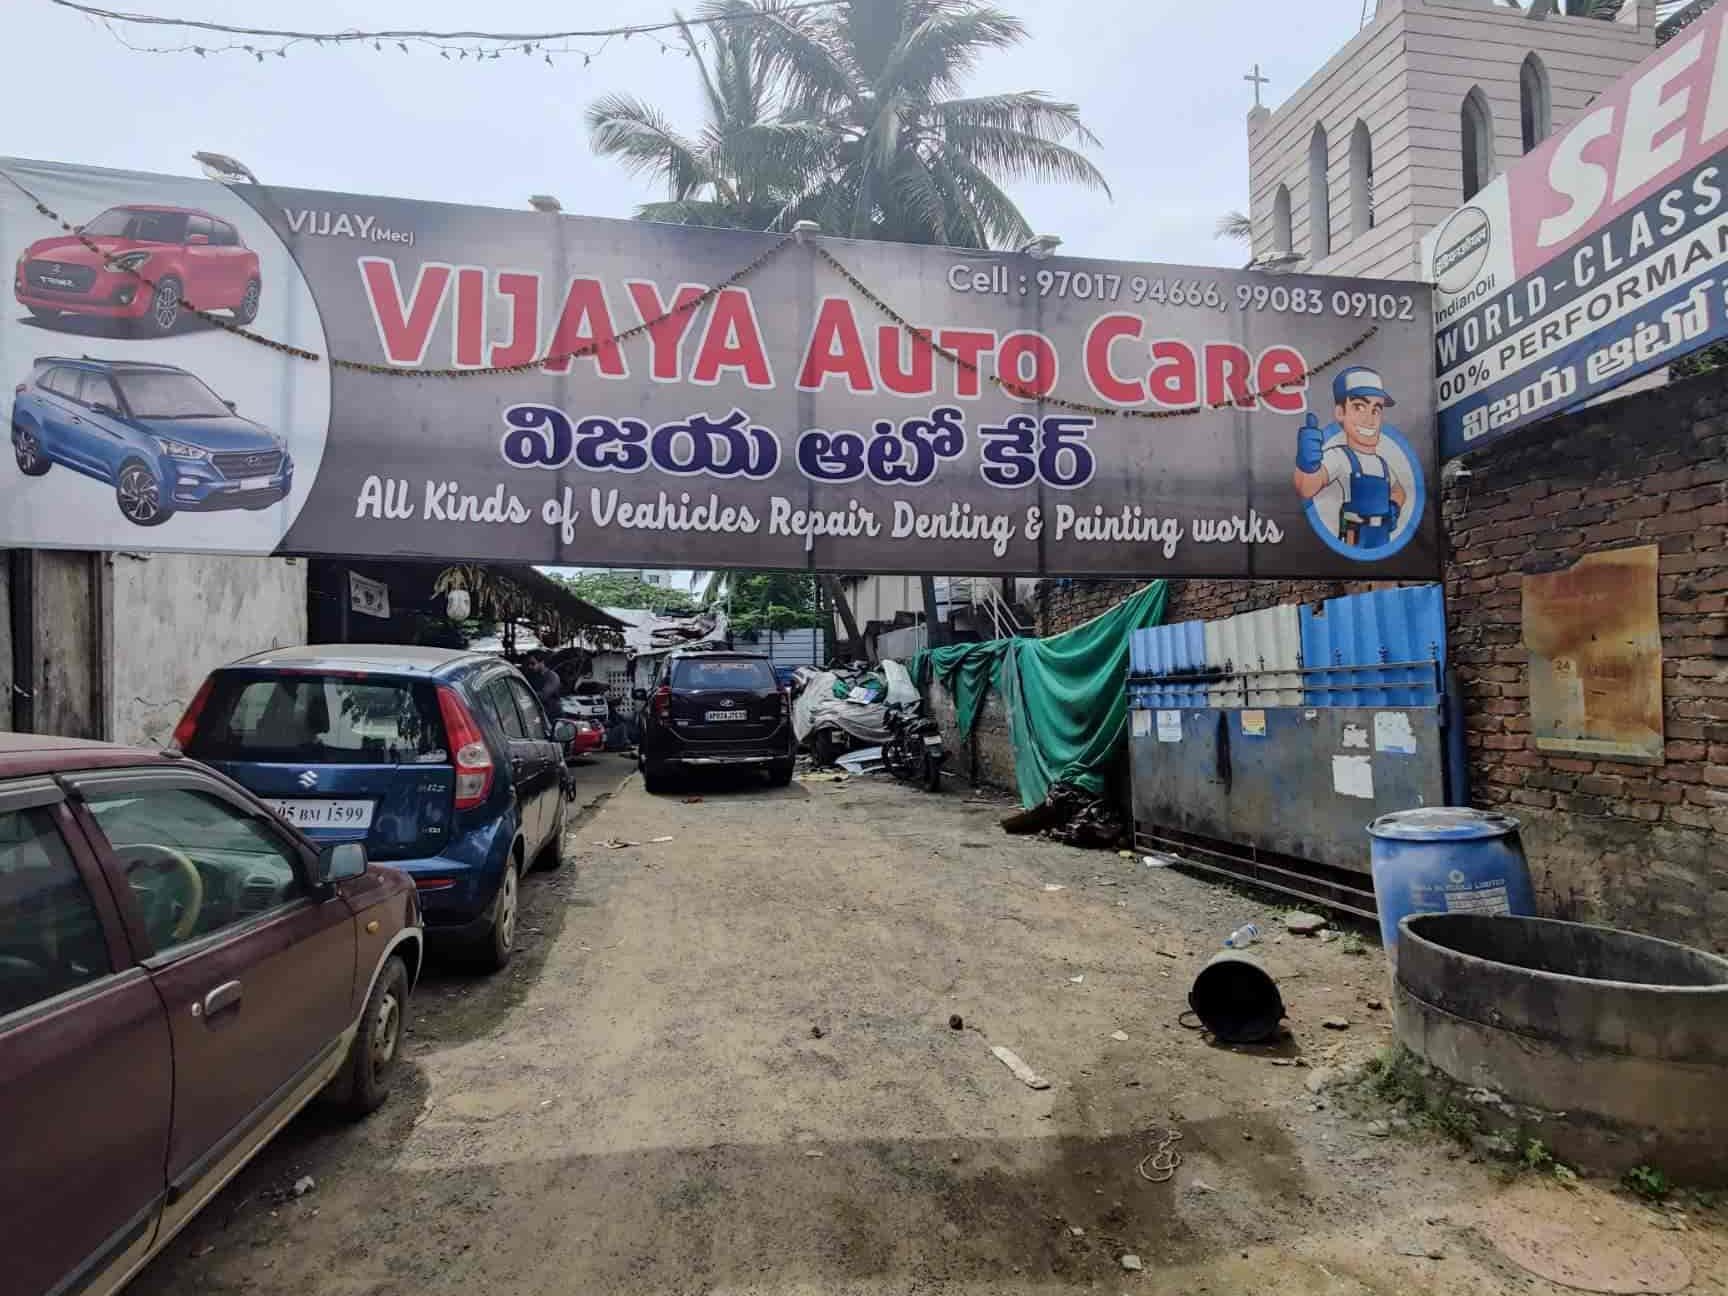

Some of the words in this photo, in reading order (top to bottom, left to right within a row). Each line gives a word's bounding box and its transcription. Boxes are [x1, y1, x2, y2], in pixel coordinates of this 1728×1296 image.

[948, 264, 1008, 296] Cell
[1036, 270, 1121, 301] 97017
[1132, 278, 1227, 312] 94666,
[1236, 284, 1323, 312] 99083
[1332, 292, 1414, 320] 09102
[1435, 272, 1495, 325] IndianOil
[1438, 167, 1721, 367] WORLD-CLASS
[357, 256, 775, 391] VIJAYA
[1462, 365, 1576, 440] విజయ
[501, 402, 780, 480] విజయ
[796, 405, 967, 485] ఆటో
[978, 413, 1097, 489] కేర్
[355, 475, 414, 519] All
[423, 480, 532, 523] Kinds
[542, 486, 579, 545] of
[591, 487, 759, 534] Veahicles
[769, 496, 880, 551] Repair
[891, 501, 1015, 557] Denting
[1025, 507, 1042, 541] &
[1055, 506, 1183, 560] Painting
[1193, 516, 1284, 546] works
[300, 808, 320, 821] BM
[327, 808, 364, 821] 1599
